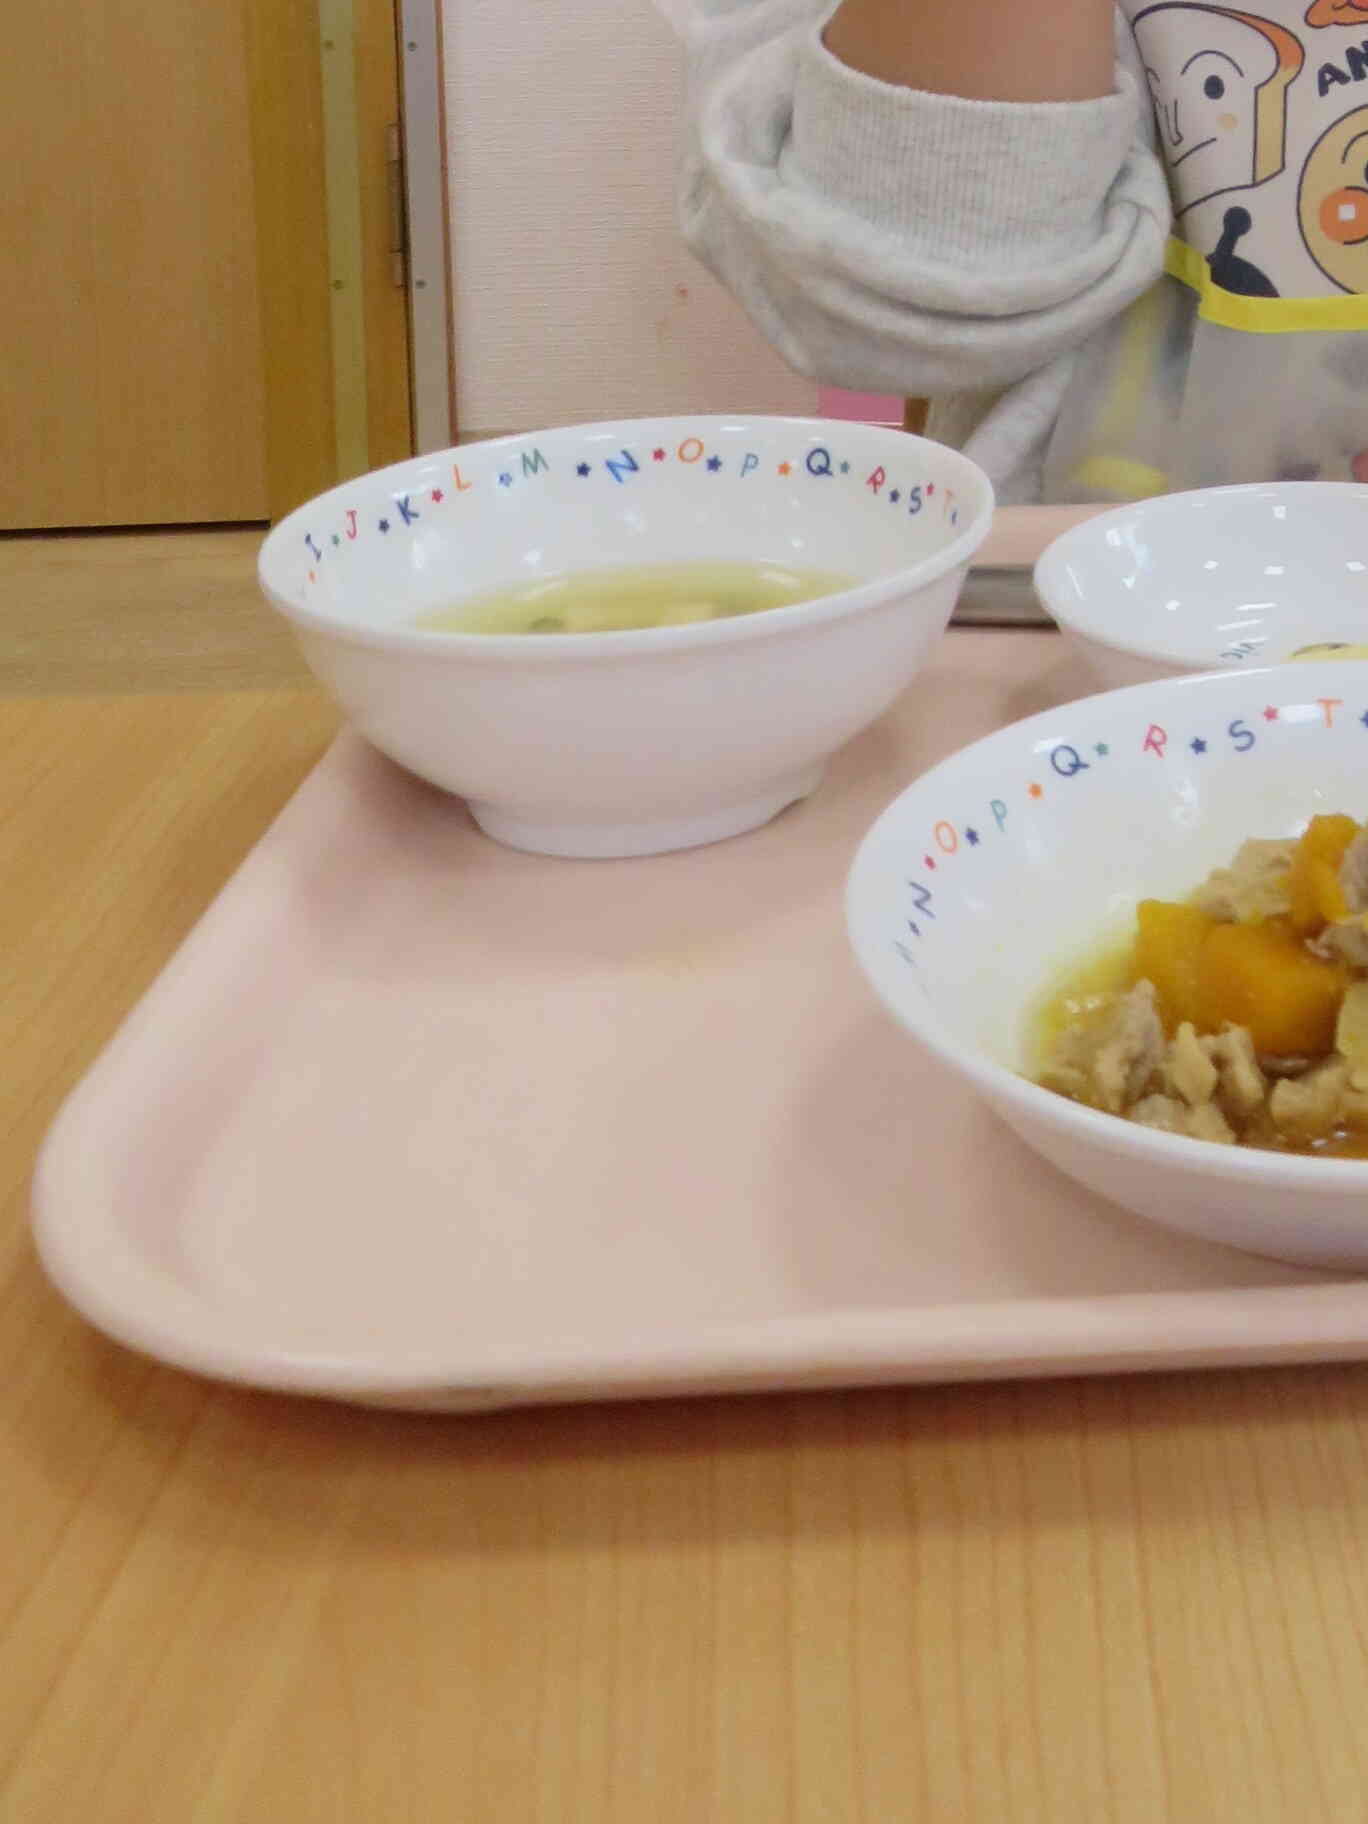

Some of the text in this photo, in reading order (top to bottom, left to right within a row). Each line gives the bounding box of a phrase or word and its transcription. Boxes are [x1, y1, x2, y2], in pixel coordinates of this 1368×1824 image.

[346, 509, 358, 541] J
[395, 495, 420, 526] K
[453, 463, 473, 492] L
[521, 447, 550, 476] M
[605, 450, 640, 484] N
[677, 437, 705, 464] O
[740, 453, 760, 478] P
[805, 447, 835, 477] Q
[865, 465, 887, 494] R
[908, 487, 923, 515] S
[934, 820, 958, 855] O
[990, 798, 1008, 833] P
[1050, 744, 1090, 777] Q
[1143, 723, 1168, 759] R
[1227, 719, 1256, 753] S
[1314, 698, 1344, 730] T
